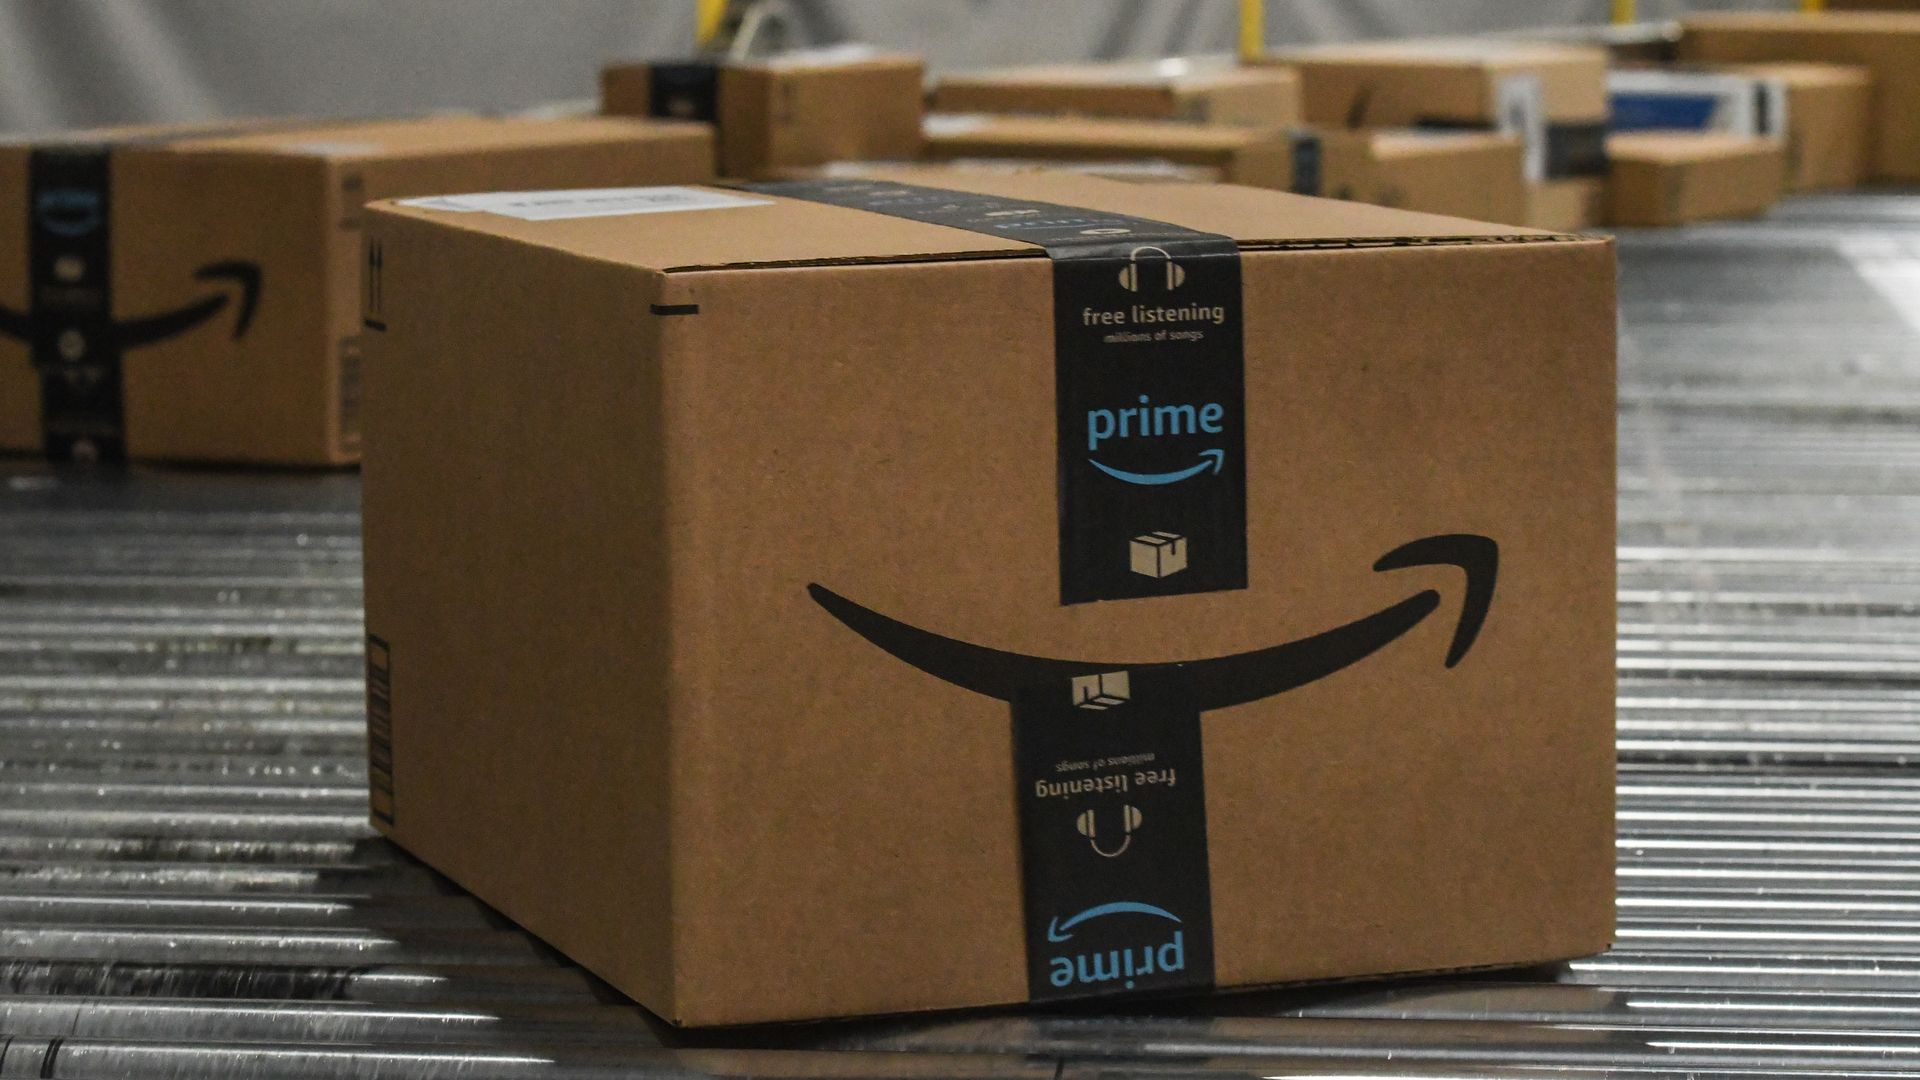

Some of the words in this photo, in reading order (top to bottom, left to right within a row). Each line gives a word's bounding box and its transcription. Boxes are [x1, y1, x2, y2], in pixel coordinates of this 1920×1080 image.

[1083, 307, 1125, 325] free
[1131, 302, 1225, 325] listening
[1103, 332, 1152, 343] millions
[1154, 330, 1168, 341] of
[1169, 331, 1204, 342] songs
[1087, 394, 1224, 450] prime
[1055, 760, 1090, 772] songs
[1092, 758, 1106, 771] of
[1106, 752, 1155, 766] millions
[1035, 774, 1128, 799] listening
[1134, 768, 1177, 787] free
[1049, 931, 1185, 990] prime
